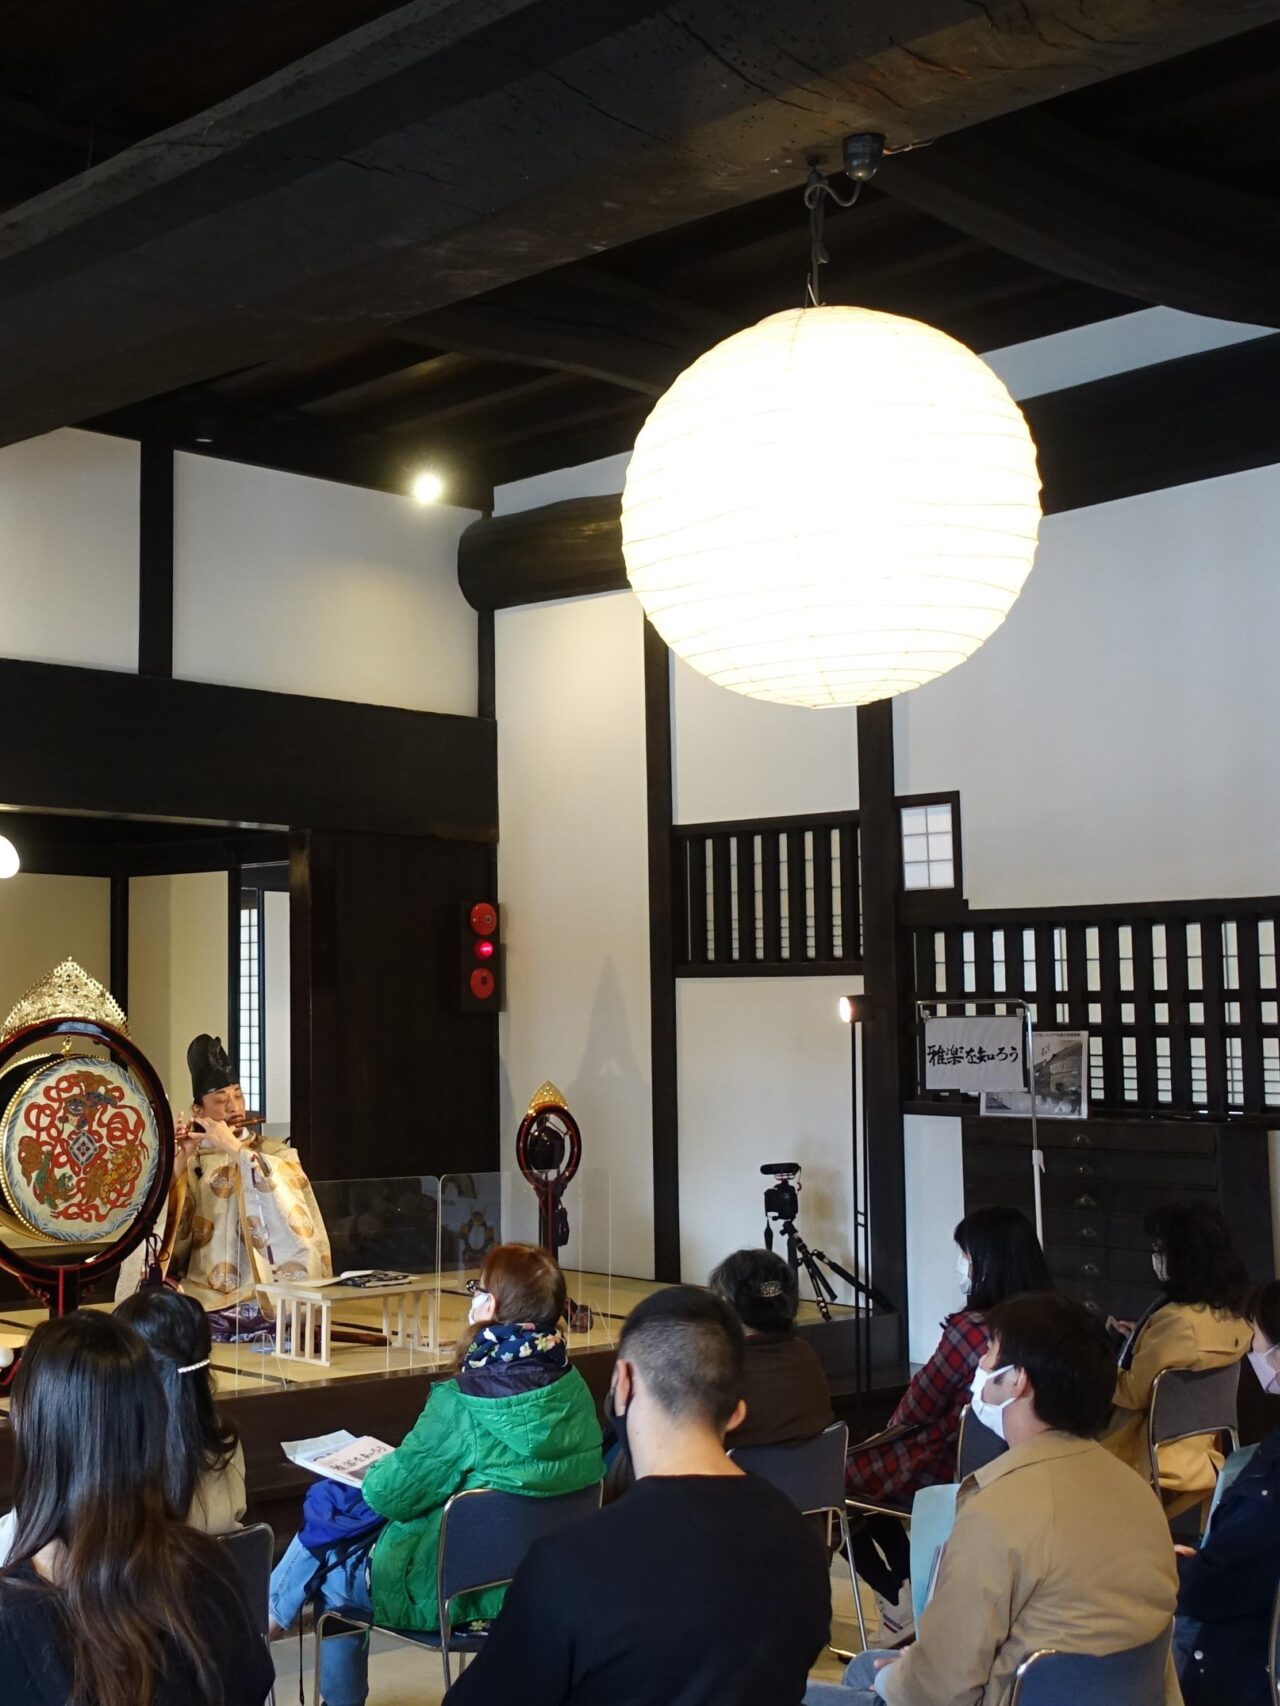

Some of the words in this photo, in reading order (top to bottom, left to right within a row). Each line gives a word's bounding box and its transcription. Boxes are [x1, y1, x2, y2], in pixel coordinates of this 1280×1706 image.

[927, 1044, 1019, 1067] 雅楽を知ろう
